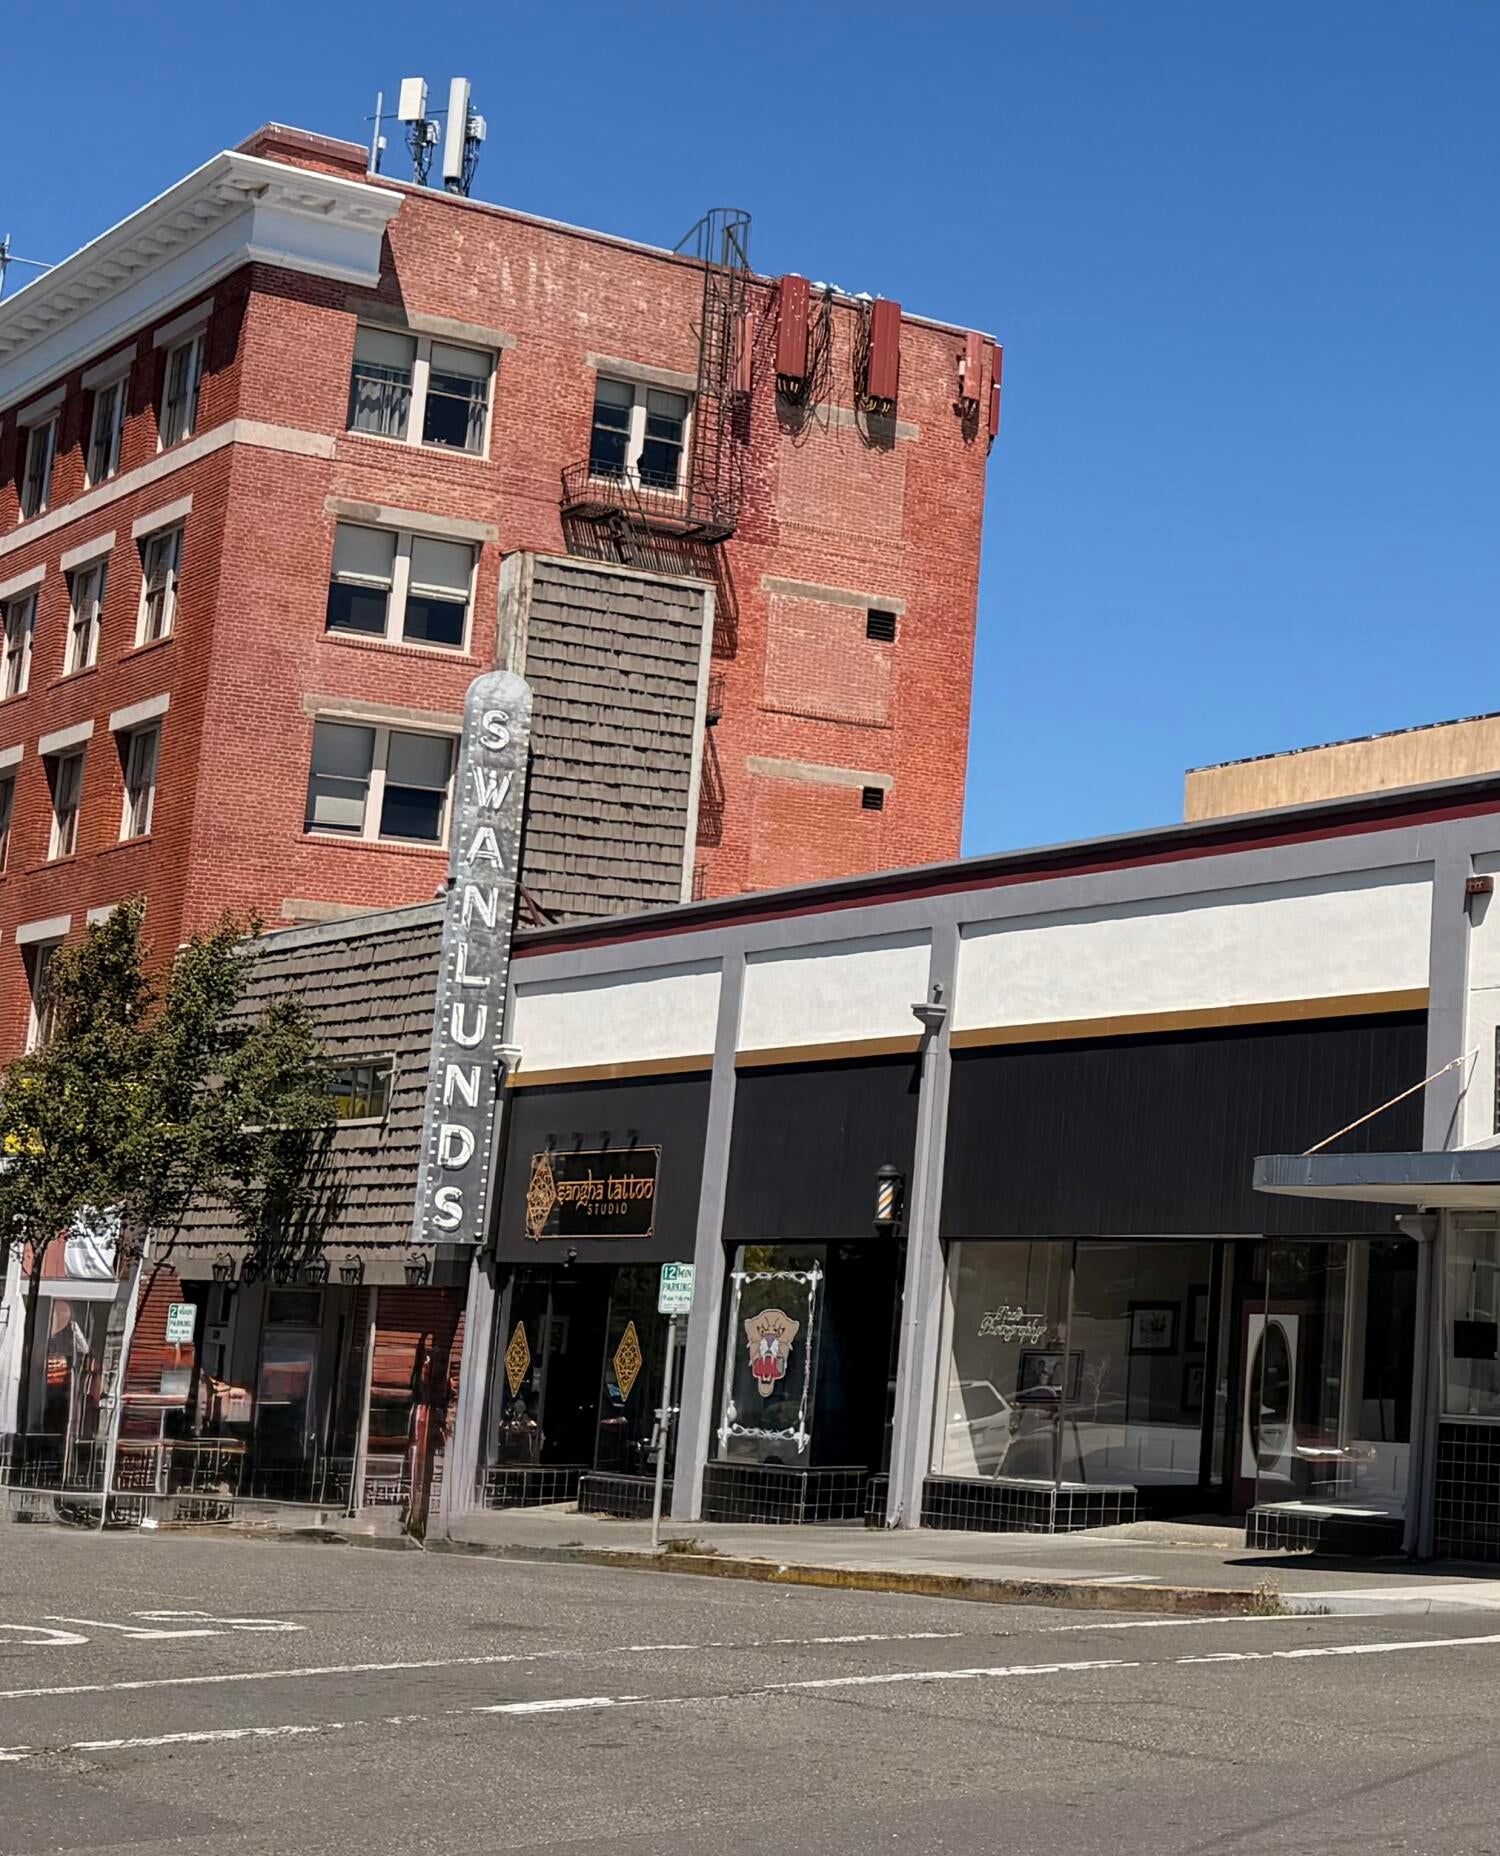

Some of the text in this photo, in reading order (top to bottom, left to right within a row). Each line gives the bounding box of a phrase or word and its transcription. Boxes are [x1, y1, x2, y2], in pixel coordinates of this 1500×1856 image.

[432, 708, 513, 1231] SWANLUNDS
[557, 1168, 654, 1210] sangha tattoo
[586, 1202, 628, 1216] STUDIO
[664, 1266, 677, 1279] 12
[170, 1306, 178, 1317] 2
